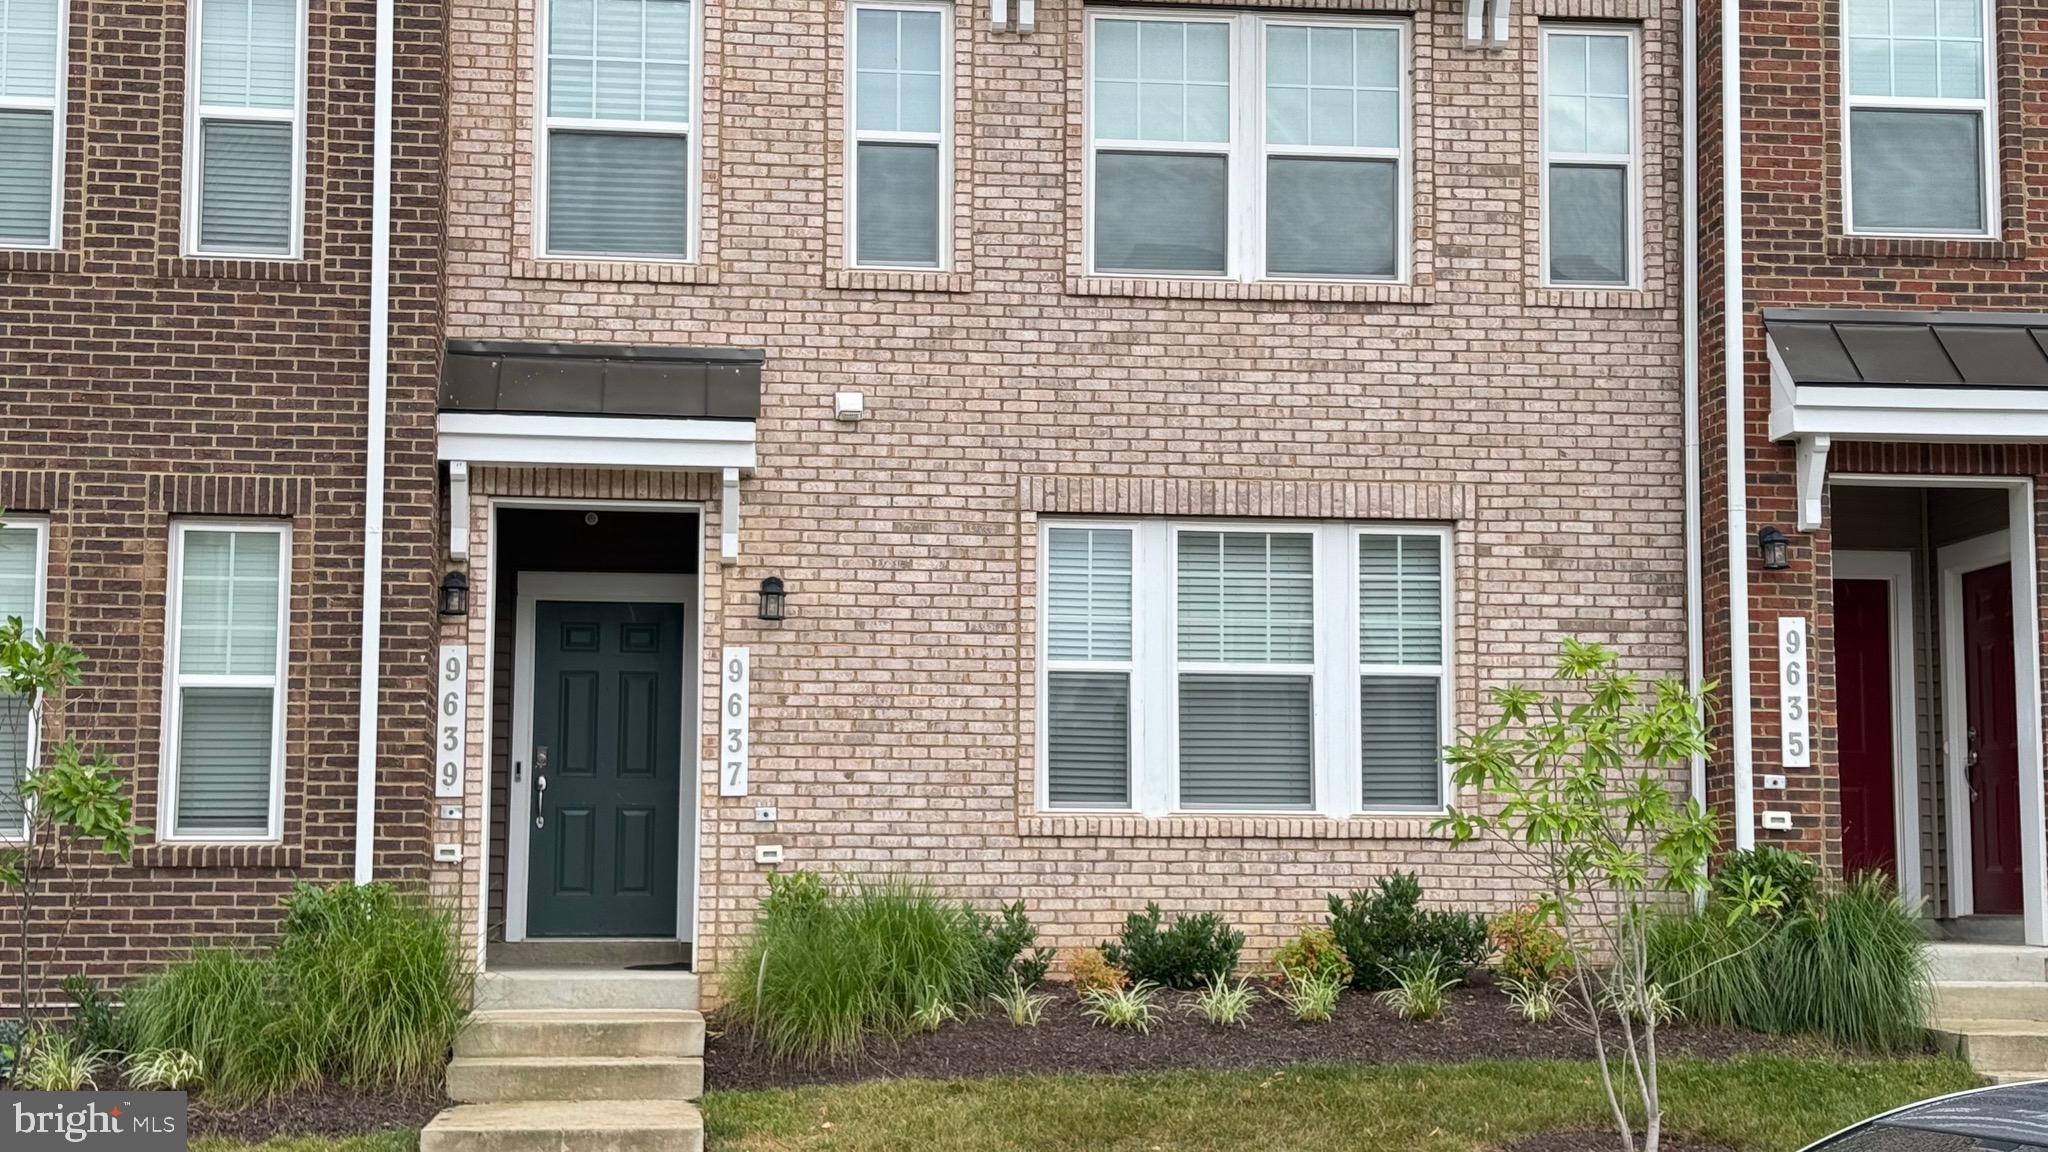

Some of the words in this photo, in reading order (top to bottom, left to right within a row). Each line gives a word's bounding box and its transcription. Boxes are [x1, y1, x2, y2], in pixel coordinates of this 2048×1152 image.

[442, 656, 461, 787] 9639
[727, 658, 744, 786] 9637
[1786, 629, 1804, 757] 9635
